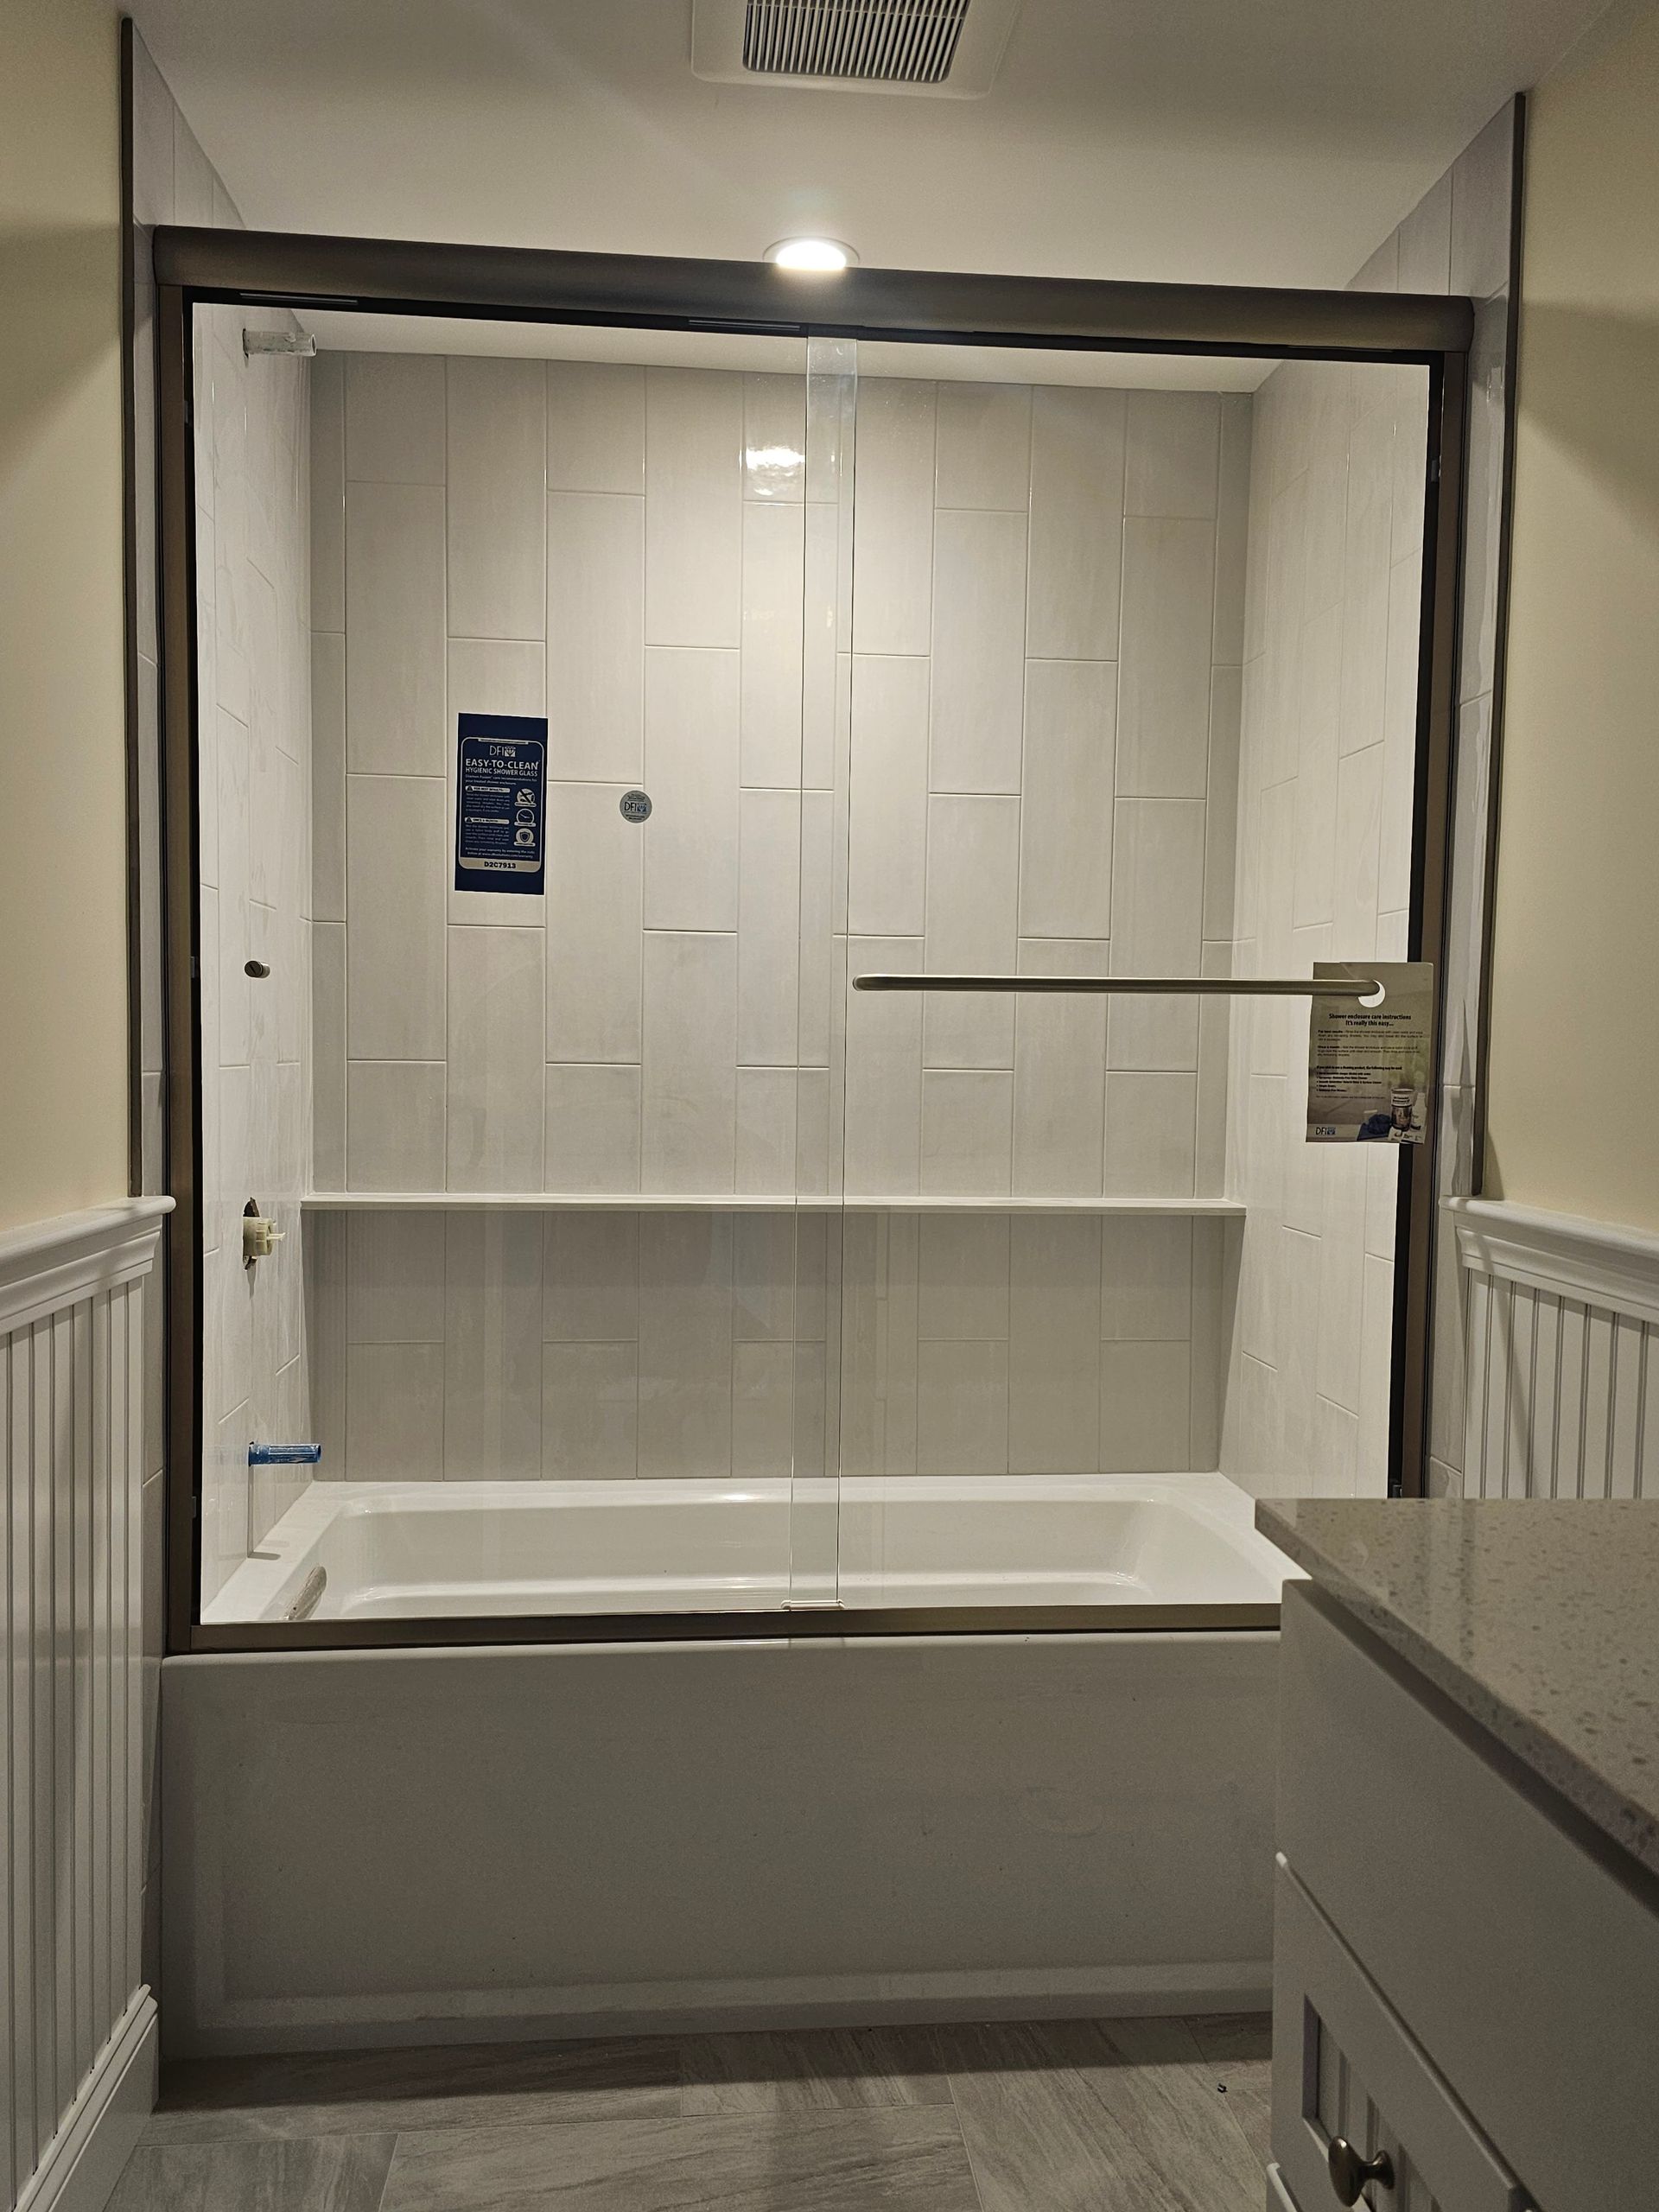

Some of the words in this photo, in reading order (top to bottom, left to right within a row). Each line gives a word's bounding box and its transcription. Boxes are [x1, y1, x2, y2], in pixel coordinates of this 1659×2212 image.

[489, 745, 505, 756] DFI
[465, 758, 538, 771] EASY-TO-CLEAN
[624, 801, 637, 811] DFI
[484, 861, 517, 869] D2C7913
[1315, 1127, 1327, 1135] DFI
